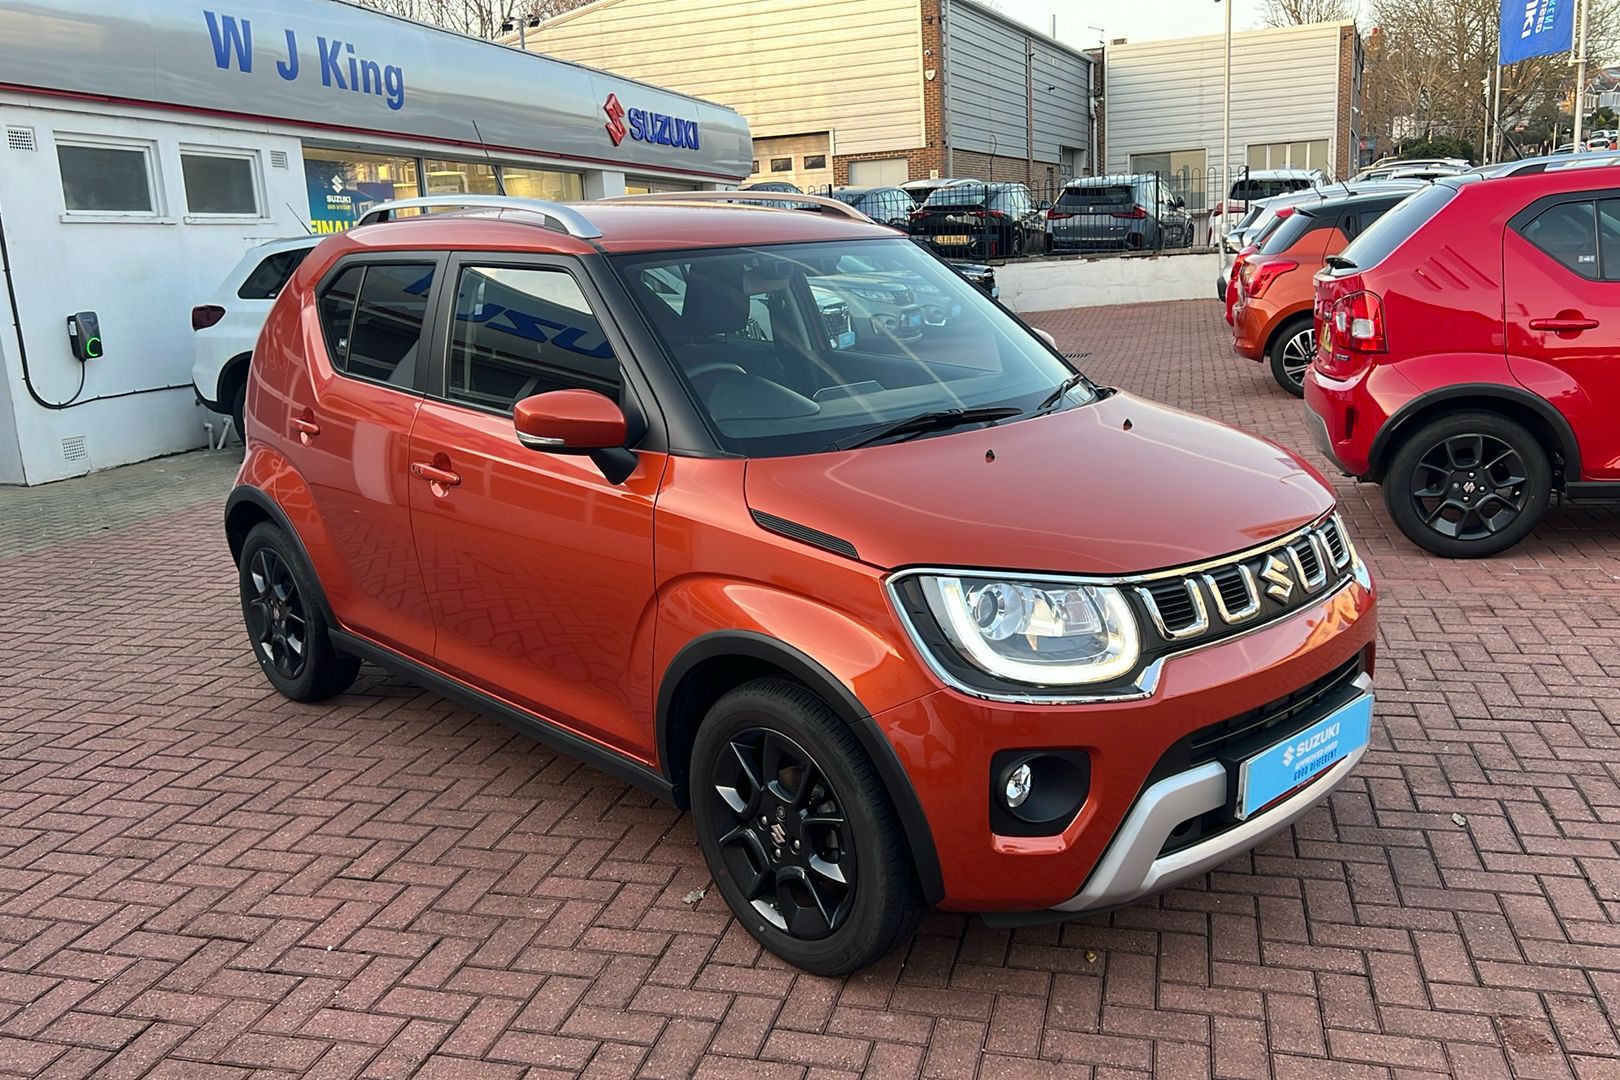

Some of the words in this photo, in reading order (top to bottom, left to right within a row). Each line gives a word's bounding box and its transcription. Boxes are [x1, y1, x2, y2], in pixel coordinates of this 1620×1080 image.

[203, 10, 252, 73] W
[276, 28, 299, 81] J
[317, 36, 404, 110] King
[628, 107, 700, 151] SUZUKI
[326, 194, 352, 203] SUZUKI
[1296, 721, 1340, 757] SUZUKI
